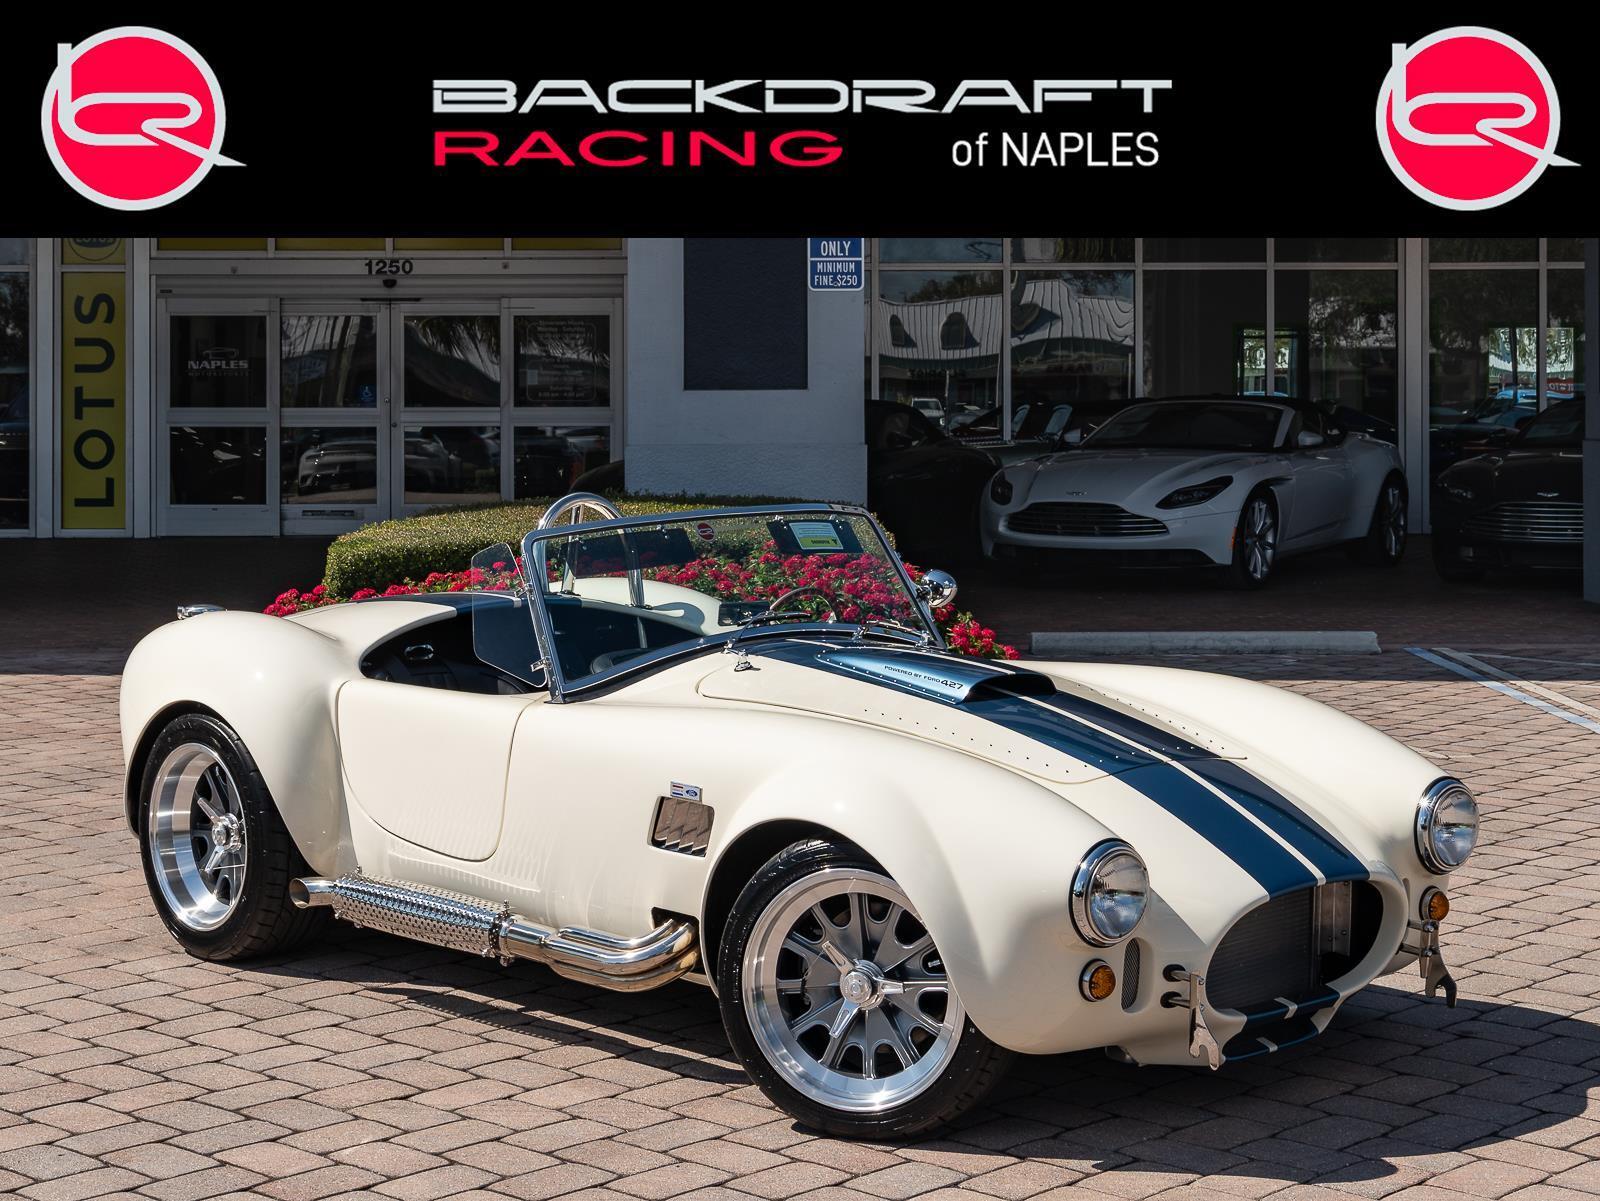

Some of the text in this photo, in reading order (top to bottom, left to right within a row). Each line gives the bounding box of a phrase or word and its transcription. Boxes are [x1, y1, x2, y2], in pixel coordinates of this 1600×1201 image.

[820, 240, 851, 256] ONLY
[364, 259, 414, 275] 1250
[817, 262, 855, 273] MINIMUM
[814, 274, 858, 287] FINE $250
[187, 360, 249, 369] NAPLES
[74, 293, 116, 507] LOTUS
[884, 665, 913, 676] POWERED
[940, 679, 964, 690] 427
